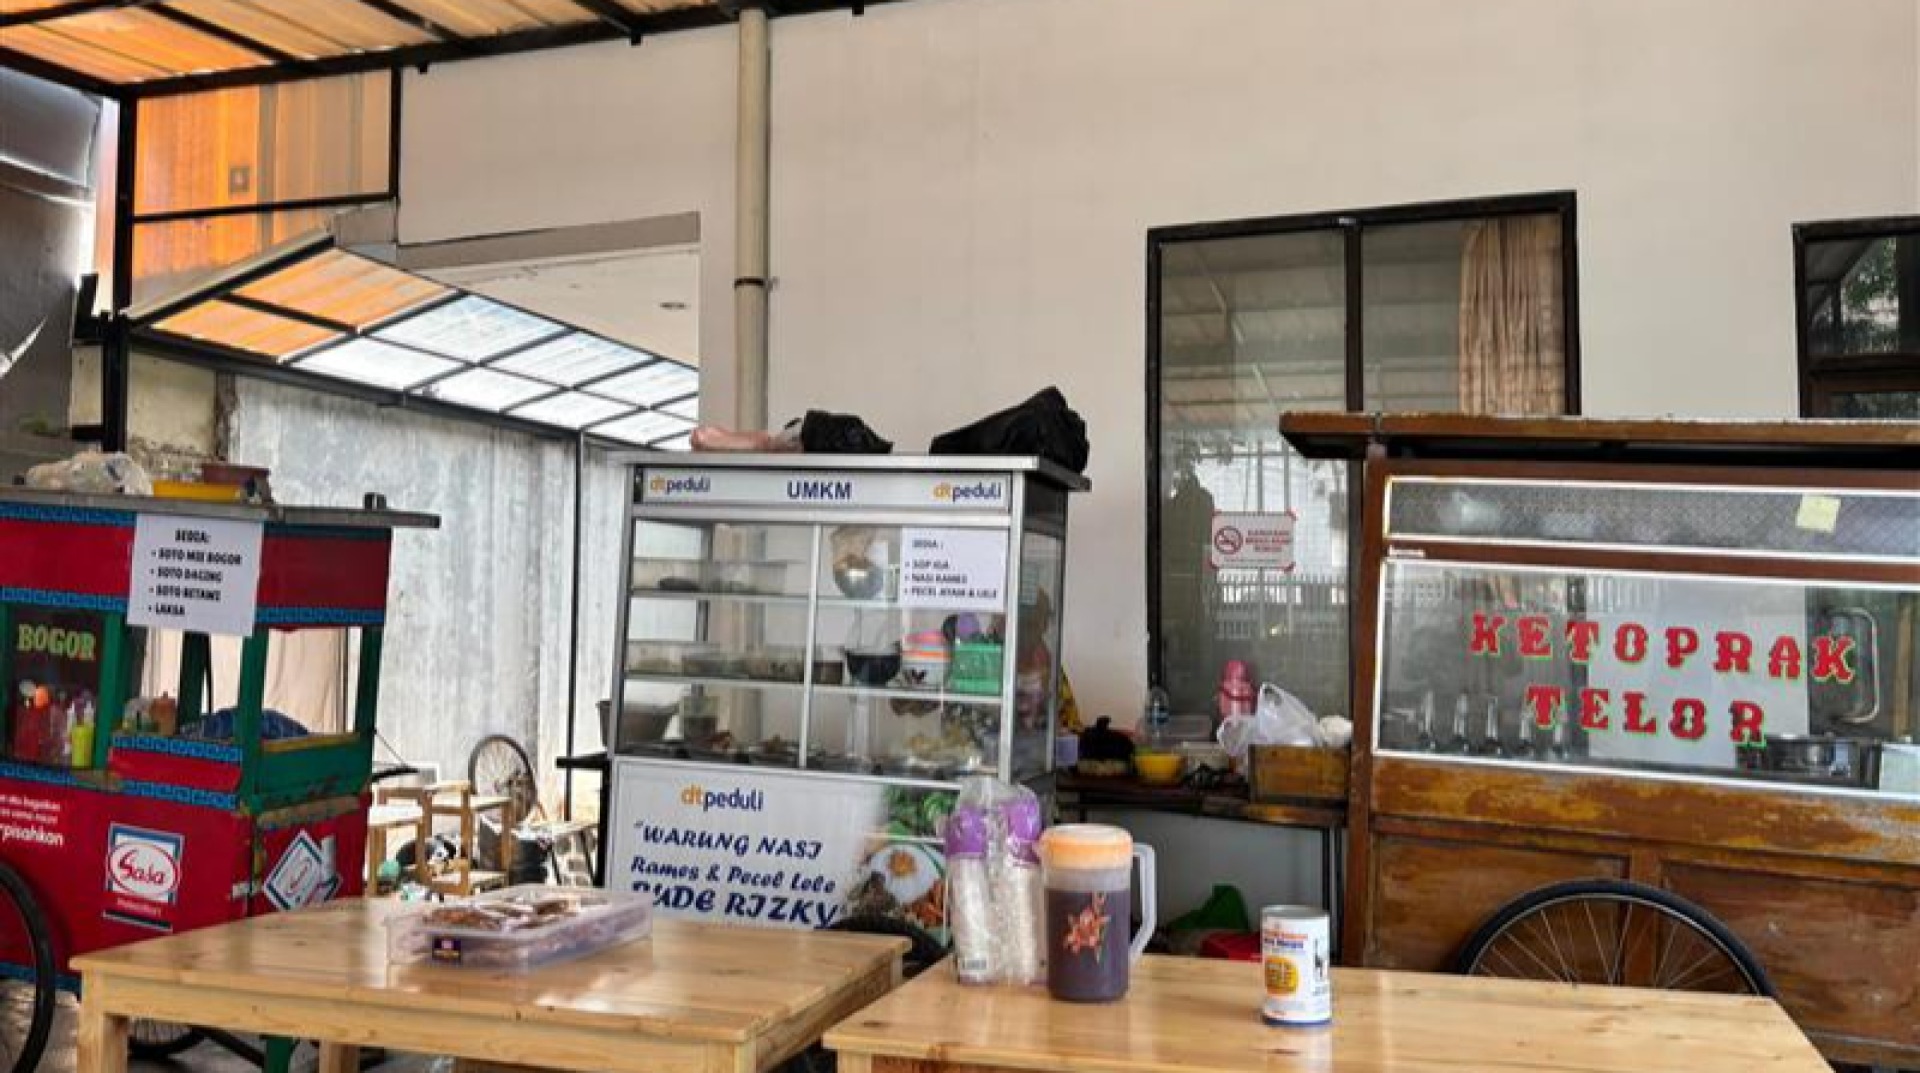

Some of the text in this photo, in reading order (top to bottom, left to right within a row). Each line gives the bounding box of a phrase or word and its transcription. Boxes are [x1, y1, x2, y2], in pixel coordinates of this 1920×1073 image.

[787, 480, 852, 500] UMKM
[158, 547, 185, 560] SOTO
[206, 551, 242, 565] BOGOR
[157, 566, 222, 582] SOTO DAGING
[155, 585, 181, 598] SOTO
[155, 603, 186, 615] LAKSA
[18, 623, 97, 661] BOGOR
[1469, 610, 1853, 683] KETOPRAK
[1524, 684, 1767, 748] TELOR
[681, 784, 763, 812] dtpeduli
[755, 836, 823, 860] NASI
[631, 855, 699, 881] Rames
[705, 863, 721, 882] &
[727, 866, 786, 889] Pecel
